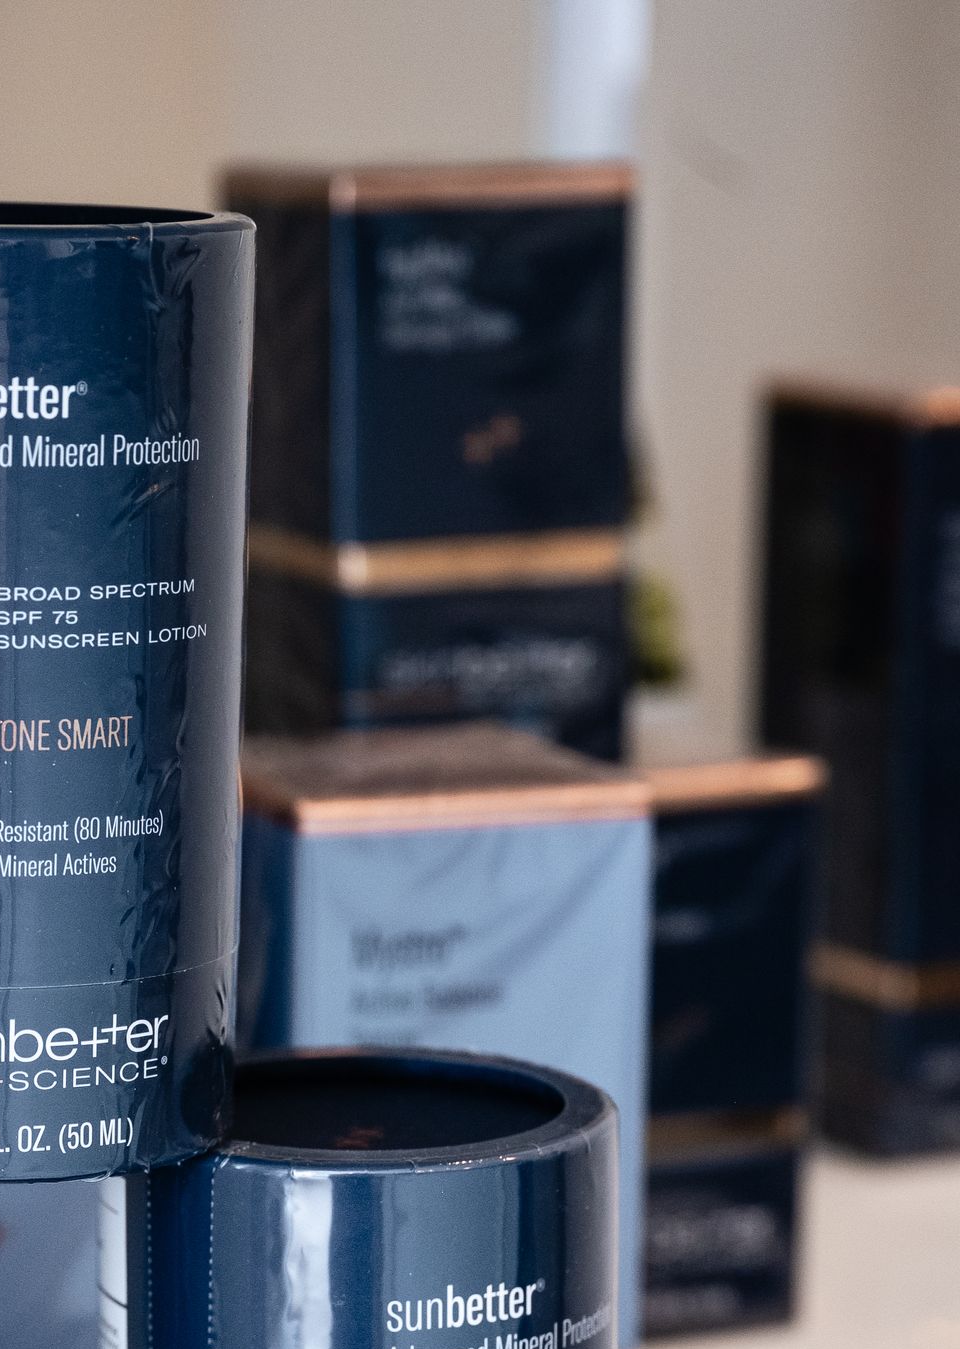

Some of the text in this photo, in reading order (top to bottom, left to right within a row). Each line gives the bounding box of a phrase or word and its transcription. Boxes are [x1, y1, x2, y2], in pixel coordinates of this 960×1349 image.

[22, 434, 105, 468] Mineral
[112, 432, 200, 467] Protection
[90, 578, 196, 600] SPECTRUM
[52, 610, 79, 625] 75
[148, 623, 207, 644] LOTION
[57, 715, 133, 751] SMART
[73, 815, 100, 844] (80
[105, 809, 164, 840] Minutes)
[62, 852, 117, 876] Actives
[17, 1124, 51, 1152] OZ.
[58, 1120, 93, 1154] (50
[99, 1116, 134, 1148] ML)
